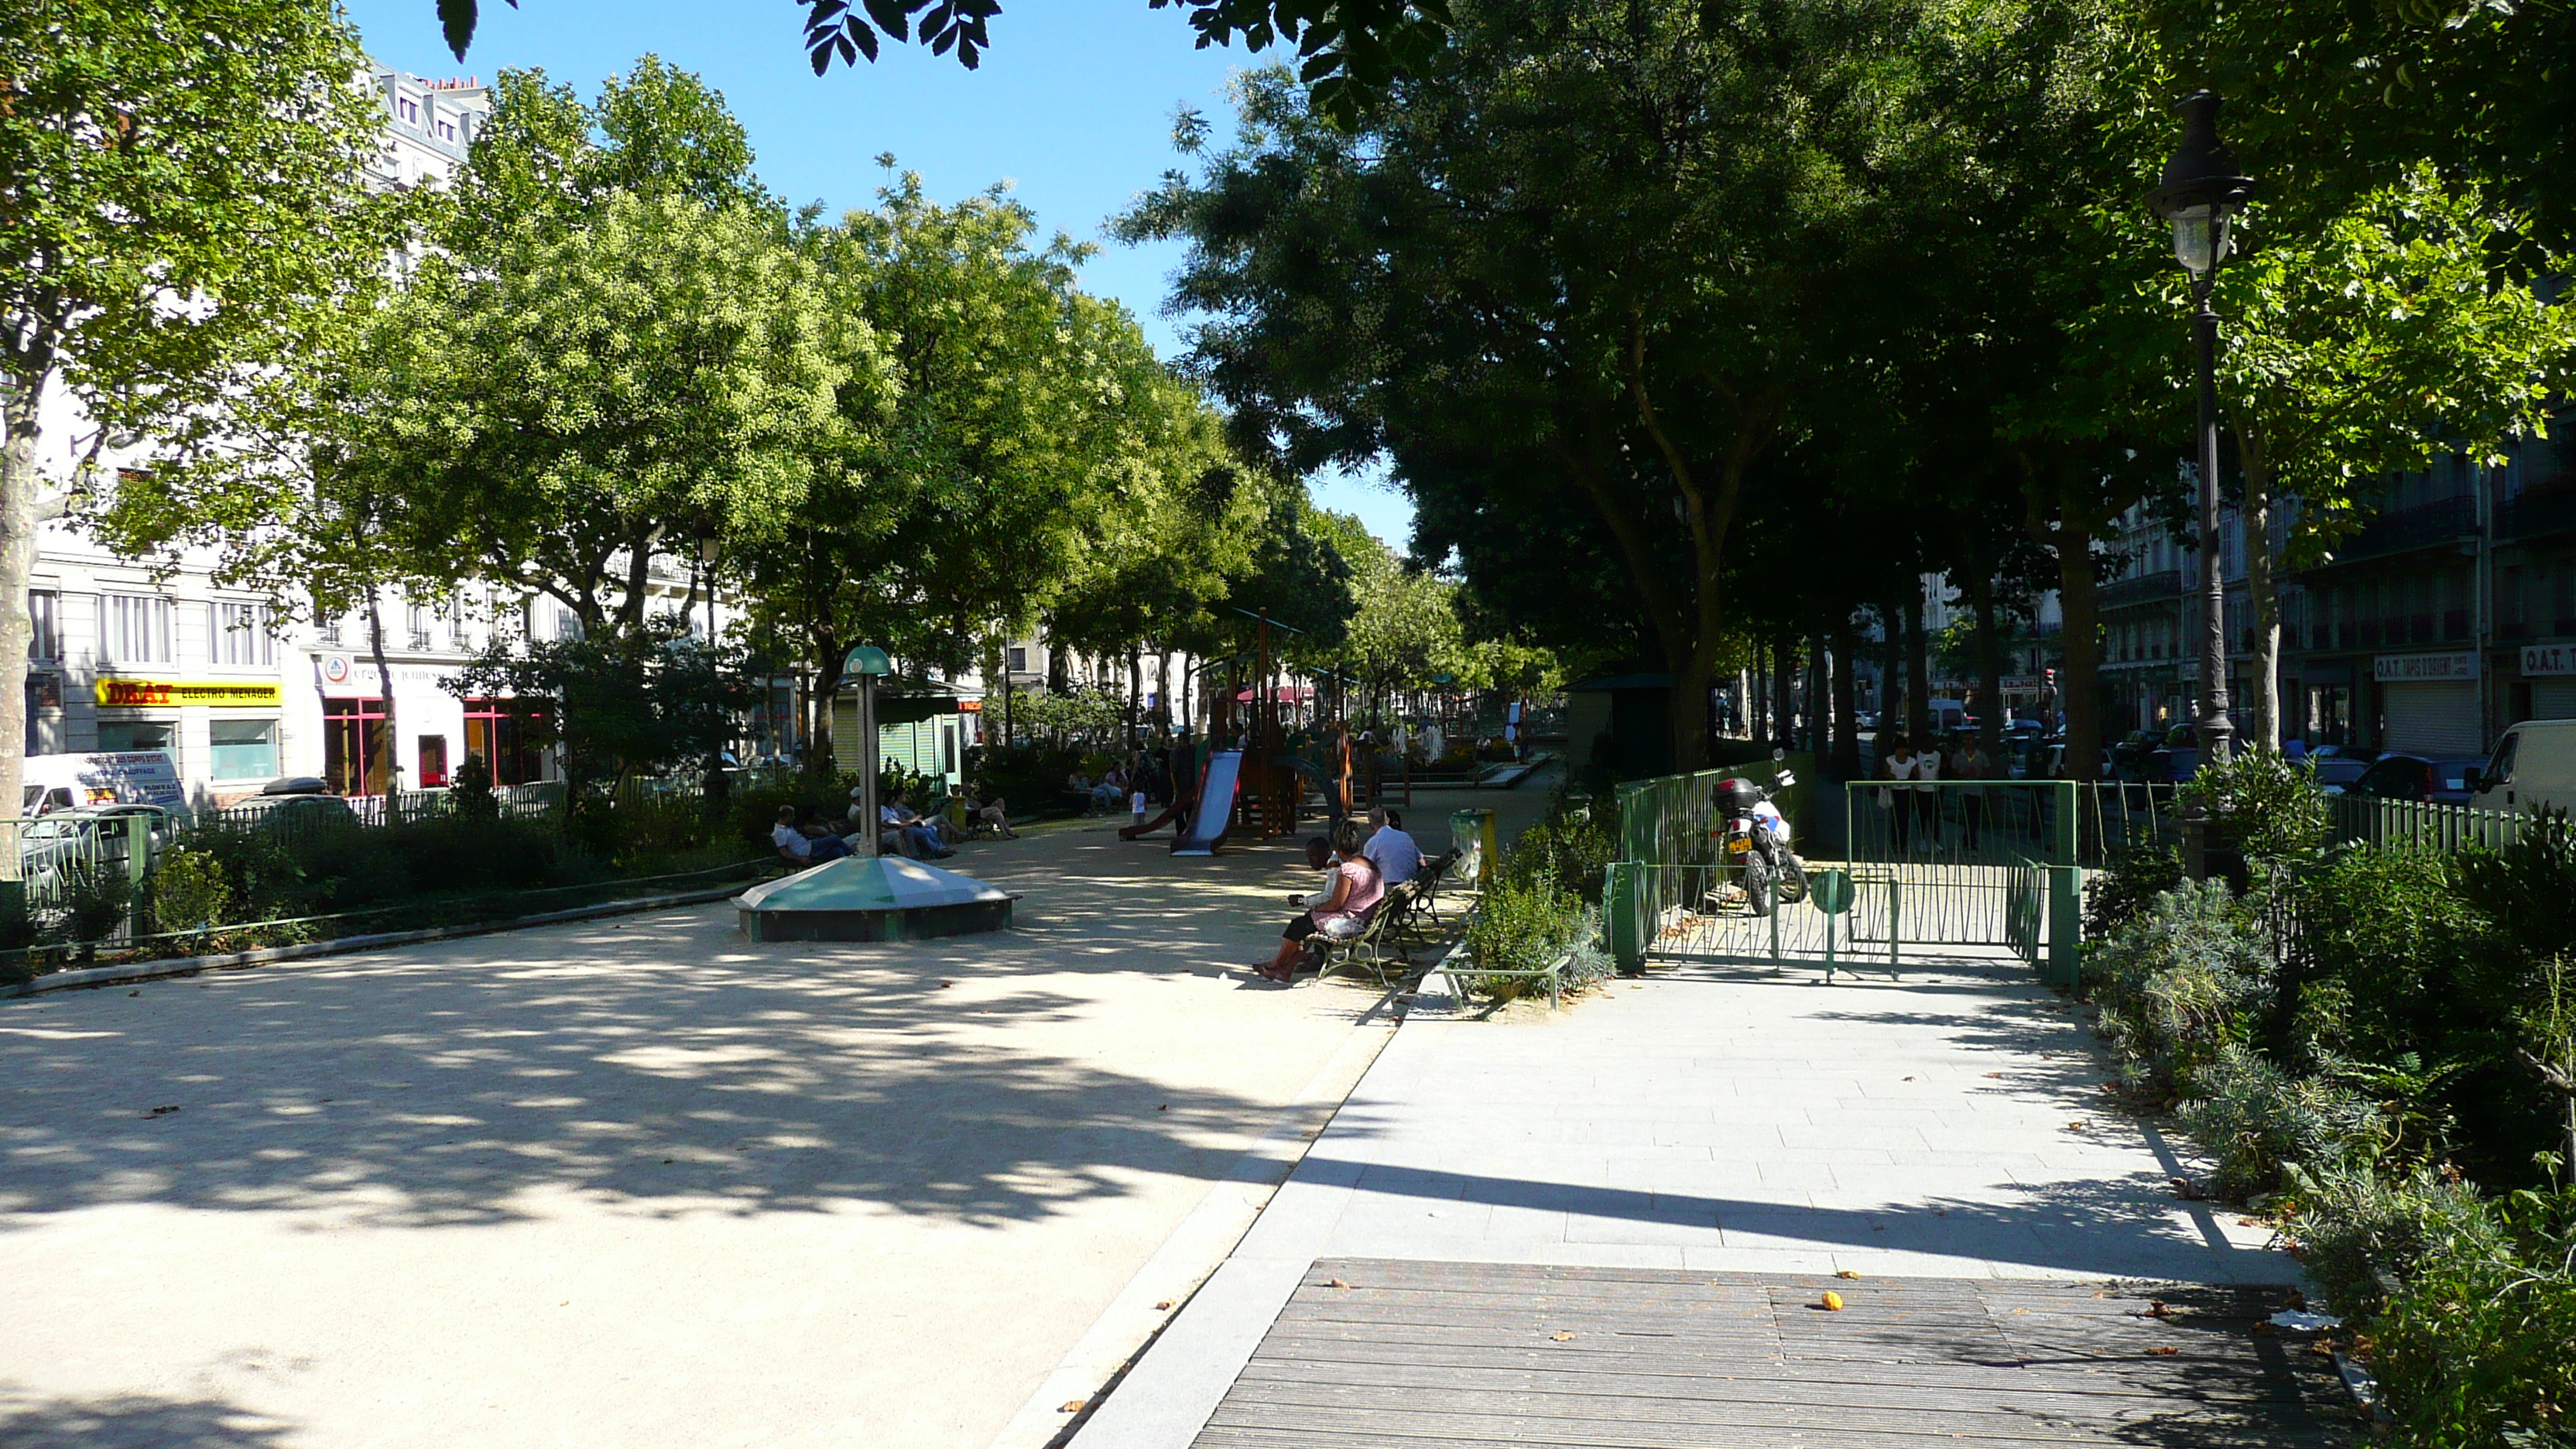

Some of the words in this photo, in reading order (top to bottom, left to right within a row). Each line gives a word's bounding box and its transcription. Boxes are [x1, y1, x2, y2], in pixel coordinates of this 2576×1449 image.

[107, 683, 173, 704] DRAY
[182, 687, 224, 698] ELECTRO
[230, 687, 276, 698] MENAGER
